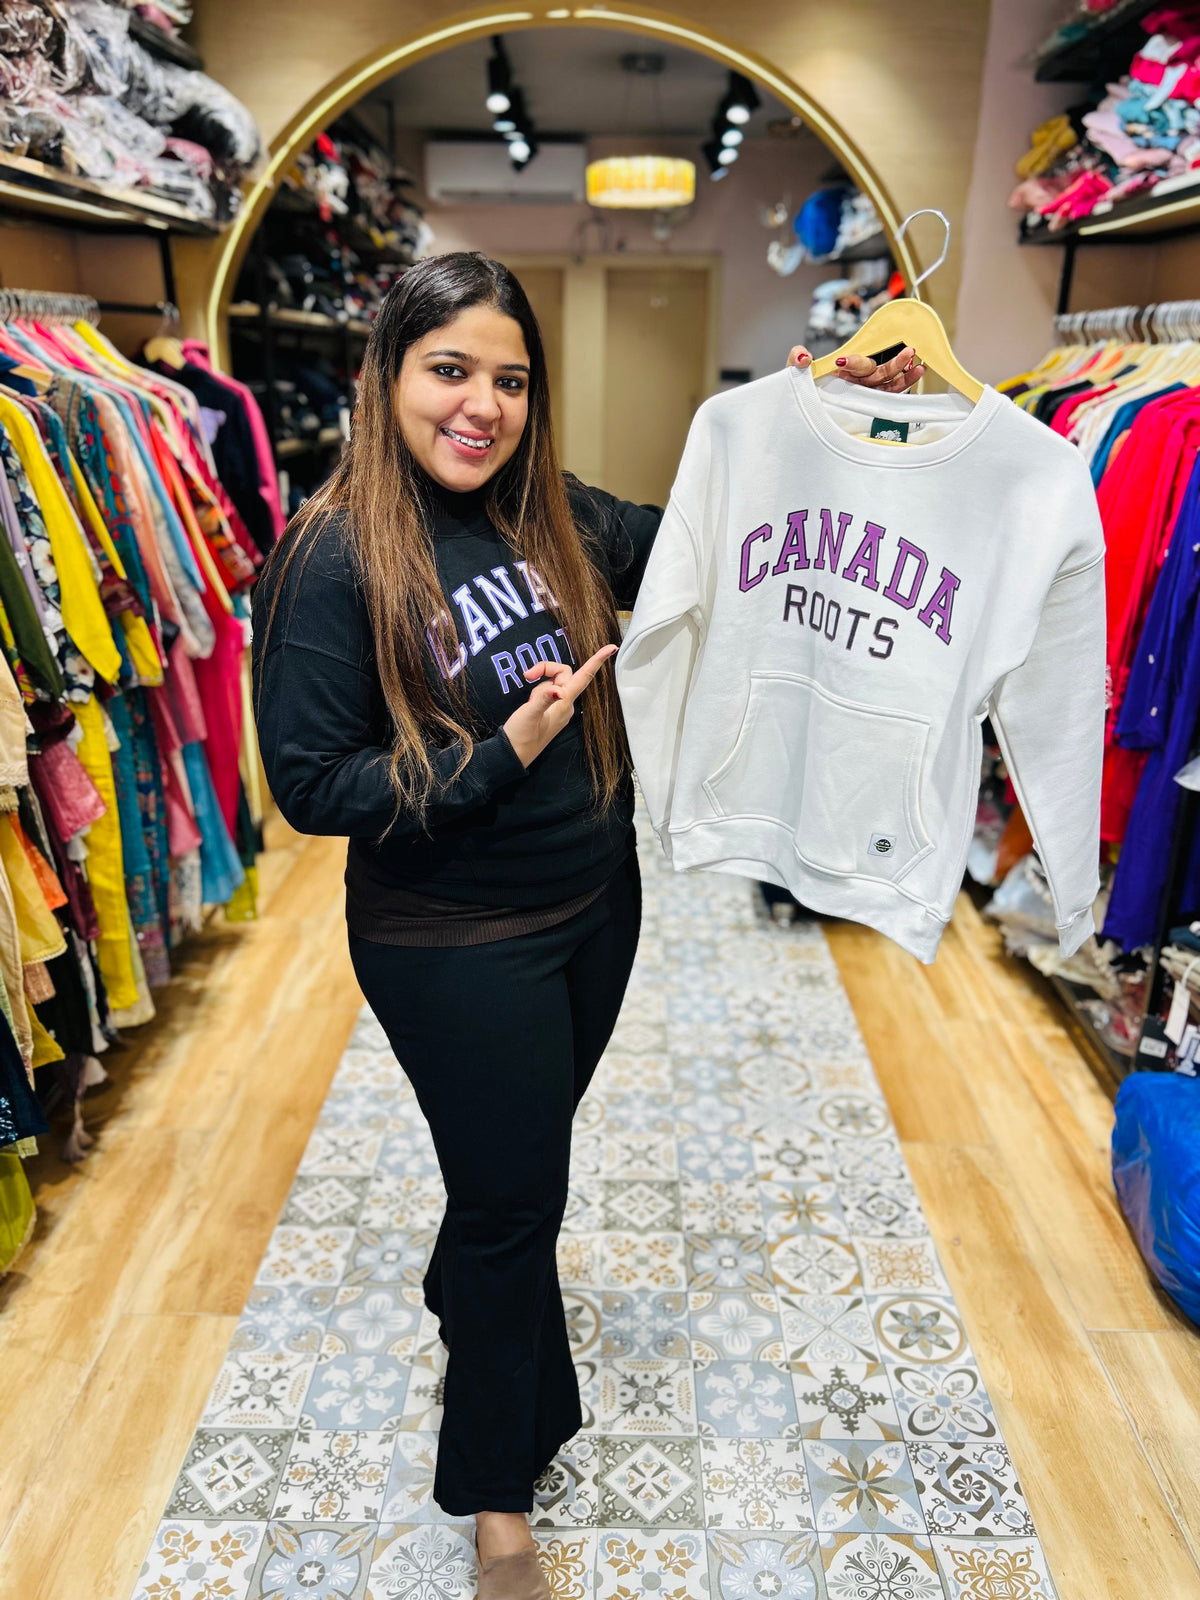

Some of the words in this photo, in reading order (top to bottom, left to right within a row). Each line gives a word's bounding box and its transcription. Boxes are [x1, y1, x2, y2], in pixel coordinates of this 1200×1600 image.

[426, 560, 560, 680] CANA
[739, 509, 961, 645] CANADA
[783, 583, 899, 660] ROOTS
[491, 627, 575, 694] ROO
